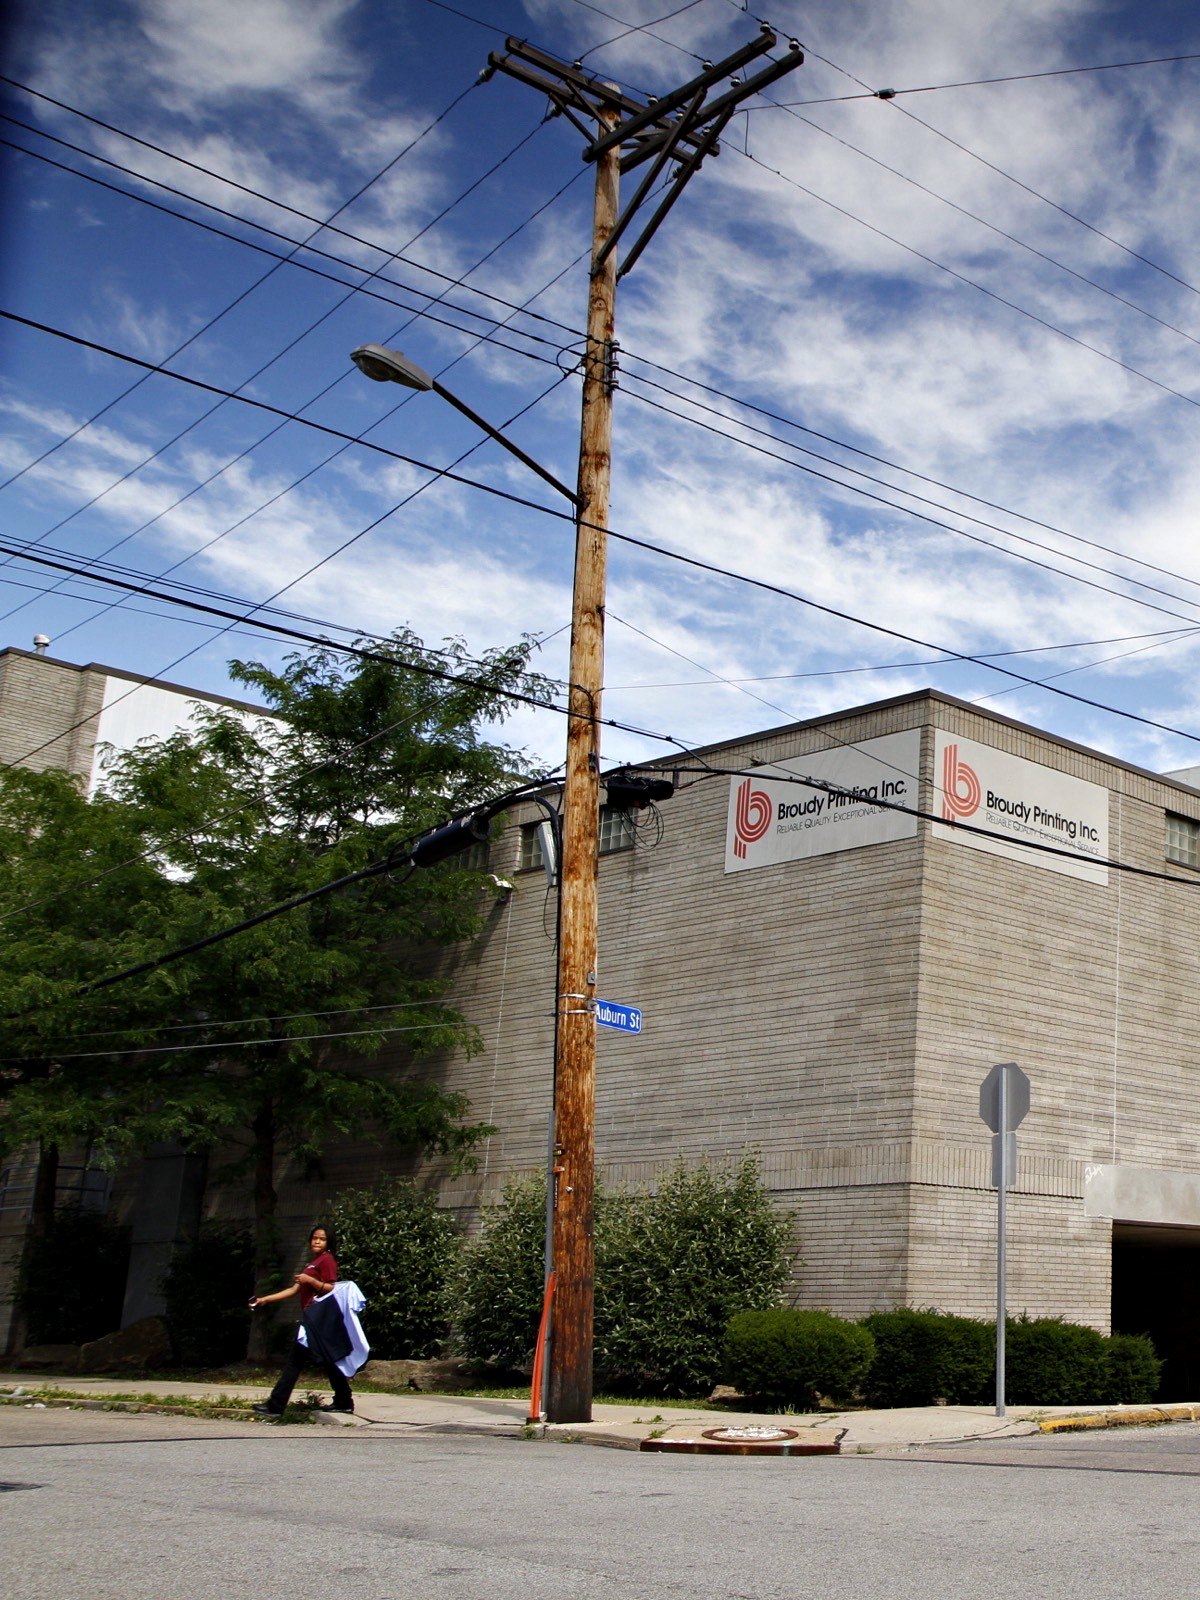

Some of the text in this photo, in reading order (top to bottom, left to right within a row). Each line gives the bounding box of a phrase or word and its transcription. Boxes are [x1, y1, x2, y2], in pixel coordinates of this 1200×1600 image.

[777, 795, 825, 820] Broudy
[881, 780, 907, 798] Inc.
[986, 790, 1100, 842] Broudy Printing Inc.
[596, 1004, 640, 1029] Auburn St
